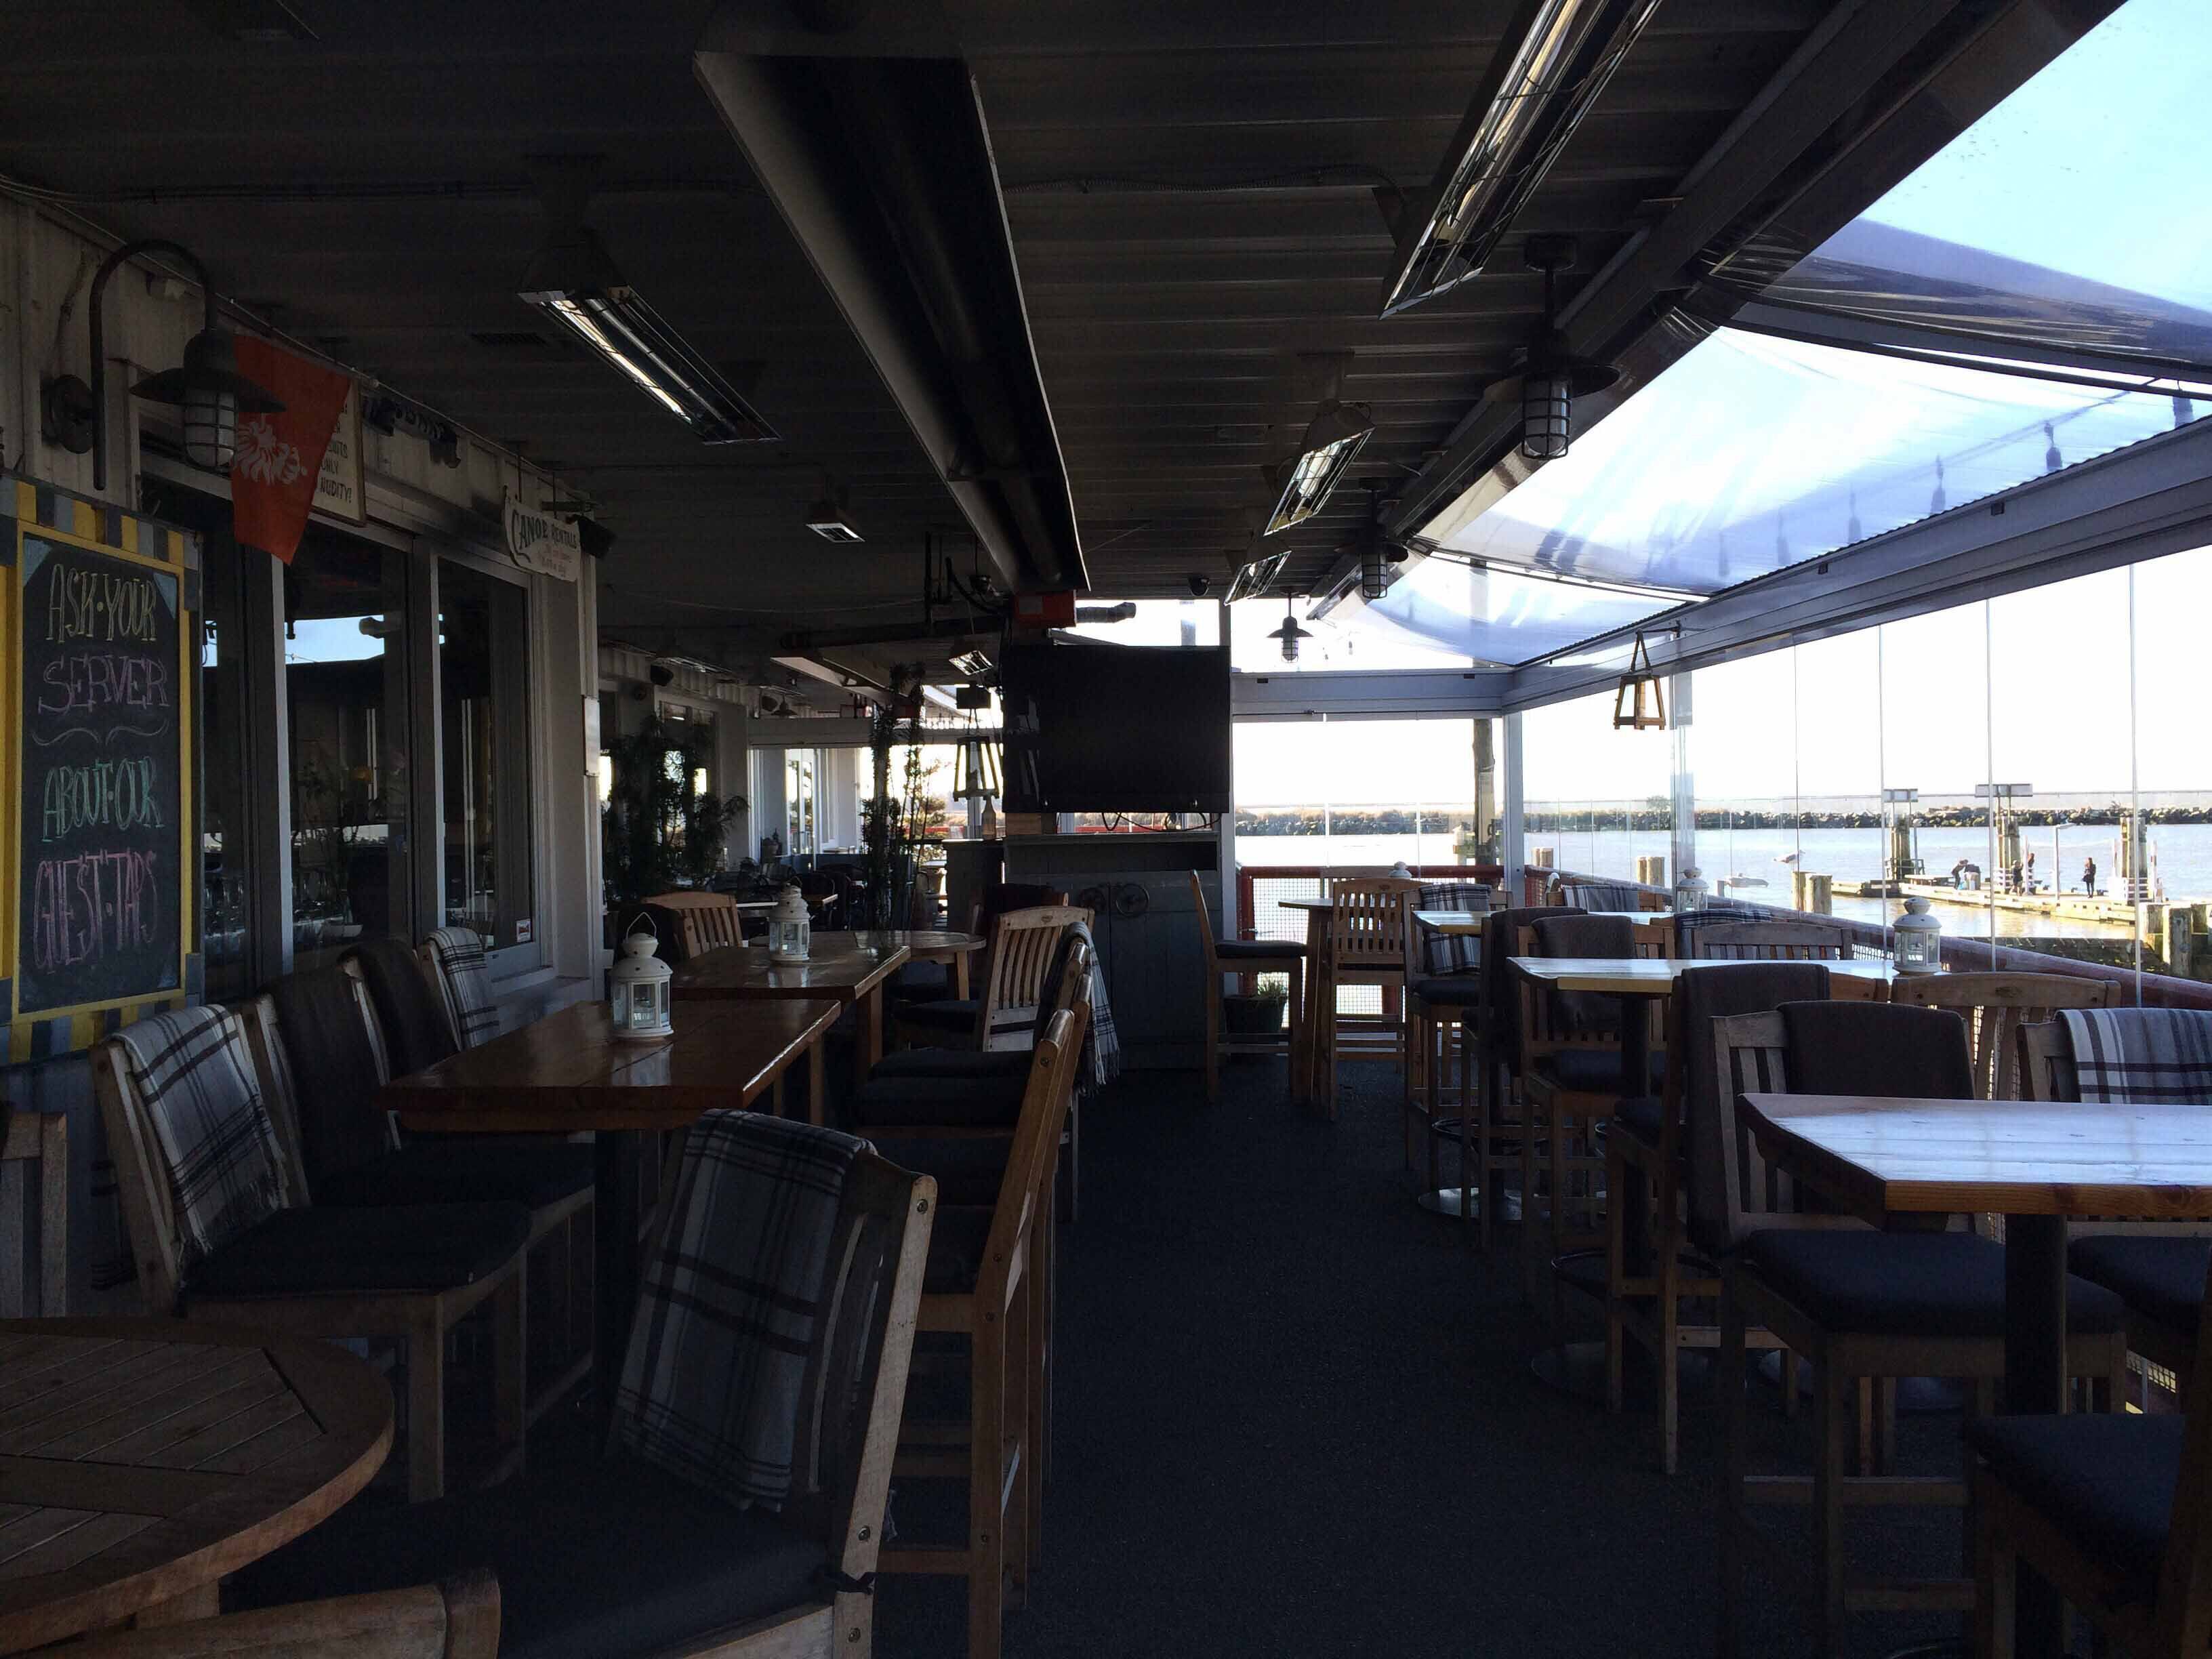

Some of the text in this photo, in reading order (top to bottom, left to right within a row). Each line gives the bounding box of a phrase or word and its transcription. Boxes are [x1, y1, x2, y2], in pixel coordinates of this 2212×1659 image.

[320, 476, 352, 504] NUDITY!
[512, 510, 548, 563] CANOE
[45, 564, 157, 643] ASK YOUR
[38, 654, 170, 714] SERVER
[41, 756, 165, 842] ABOUT OUR
[34, 848, 158, 974] GUEST TAPS
